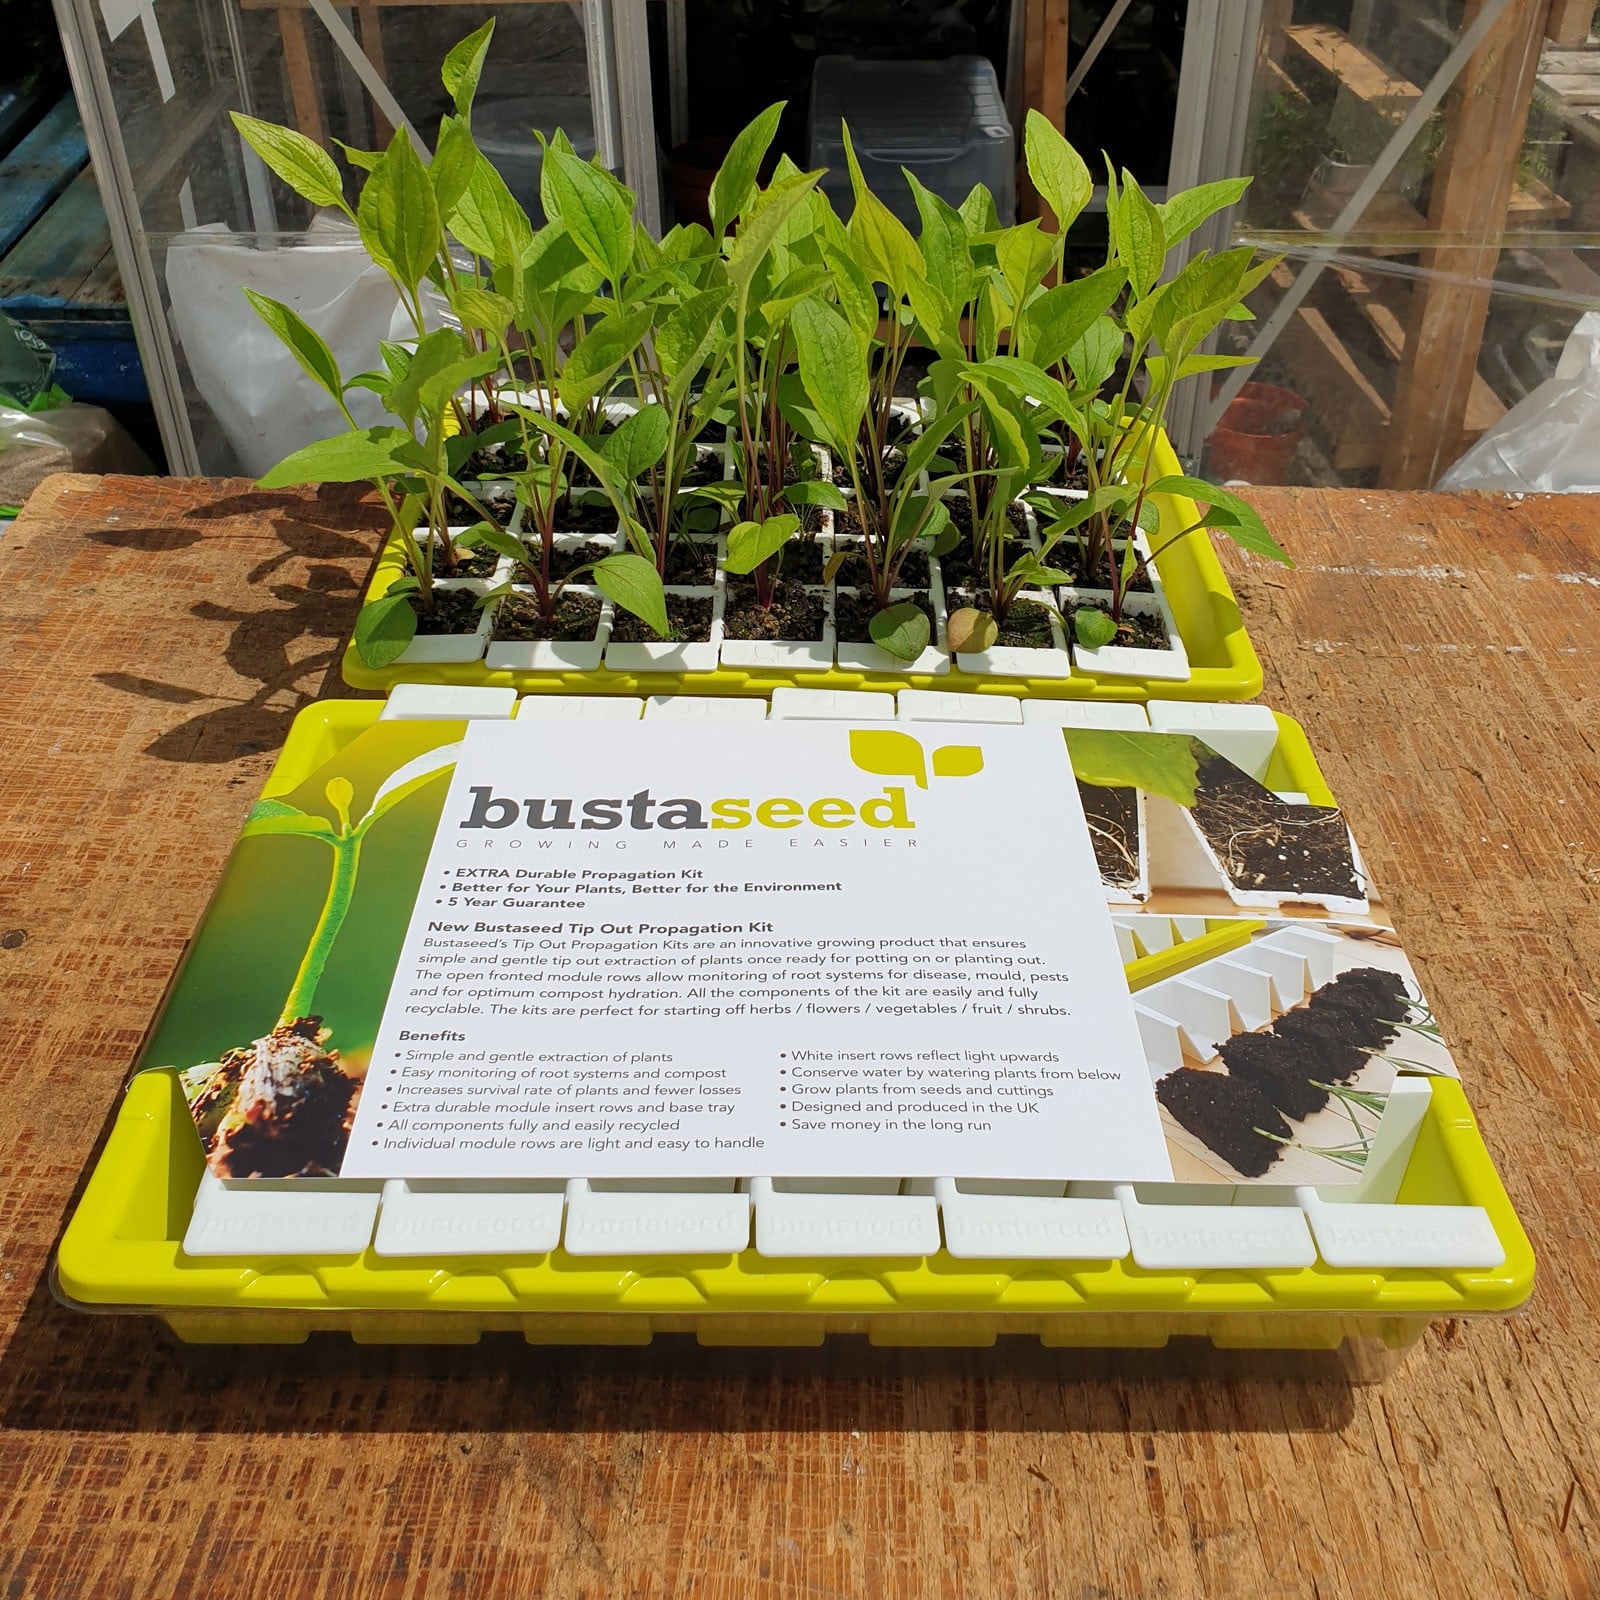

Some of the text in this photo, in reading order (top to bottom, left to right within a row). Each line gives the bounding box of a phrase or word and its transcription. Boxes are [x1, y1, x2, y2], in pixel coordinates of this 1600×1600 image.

[458, 786, 917, 831] bustaseed
[455, 837, 919, 850] GROWING MADE EASIER
[455, 868, 704, 882] EXTRA Durable Propagation Kit
[451, 881, 843, 896] Better for Your Plants, Better for the Environment
[447, 896, 586, 909] 5 Year Guarantee
[427, 921, 774, 937] New Bustaseed Tip Out Propagation Kit
[512, 938, 535, 953] Tip
[538, 939, 568, 950] Out
[570, 939, 658, 953] Propagation
[662, 939, 689, 950] Kits
[692, 941, 716, 950] are
[719, 941, 737, 949] an
[740, 937, 813, 949] innovative
[816, 937, 875, 951] growing
[879, 936, 936, 951] product
[938, 936, 968, 948] that
[971, 940, 1027, 949] ensures
[417, 952, 1046, 969] simple and gentle tip out extraction of plants once ready for potting on or planting out.
[415, 968, 1070, 985] The open fronted module rows allow monitoring of root systems for disease, mould, pests
[398, 1029, 466, 1042] Benefits
[405, 1049, 673, 1065] Simple and gentle extraction of plants
[791, 1049, 1060, 1065] White insert rows reflect light upwards
[401, 1066, 727, 1082] Easy monitoring of root systems and compost
[791, 1065, 1121, 1081] Conserve water by watering plants from below
[397, 1083, 742, 1099] Increases survival rate of plants and fewer losses
[791, 1082, 1054, 1099] Grow plants from seeds and cuttings
[392, 1100, 736, 1116] Extra durable module insert rows and base tray
[791, 1099, 1040, 1116] Designed and produced in the UK
[387, 1118, 680, 1134] All components fully and easily recycled
[791, 1117, 992, 1134] Save money in the long run
[383, 1135, 765, 1152] Individual module rows are light and easy to handle
